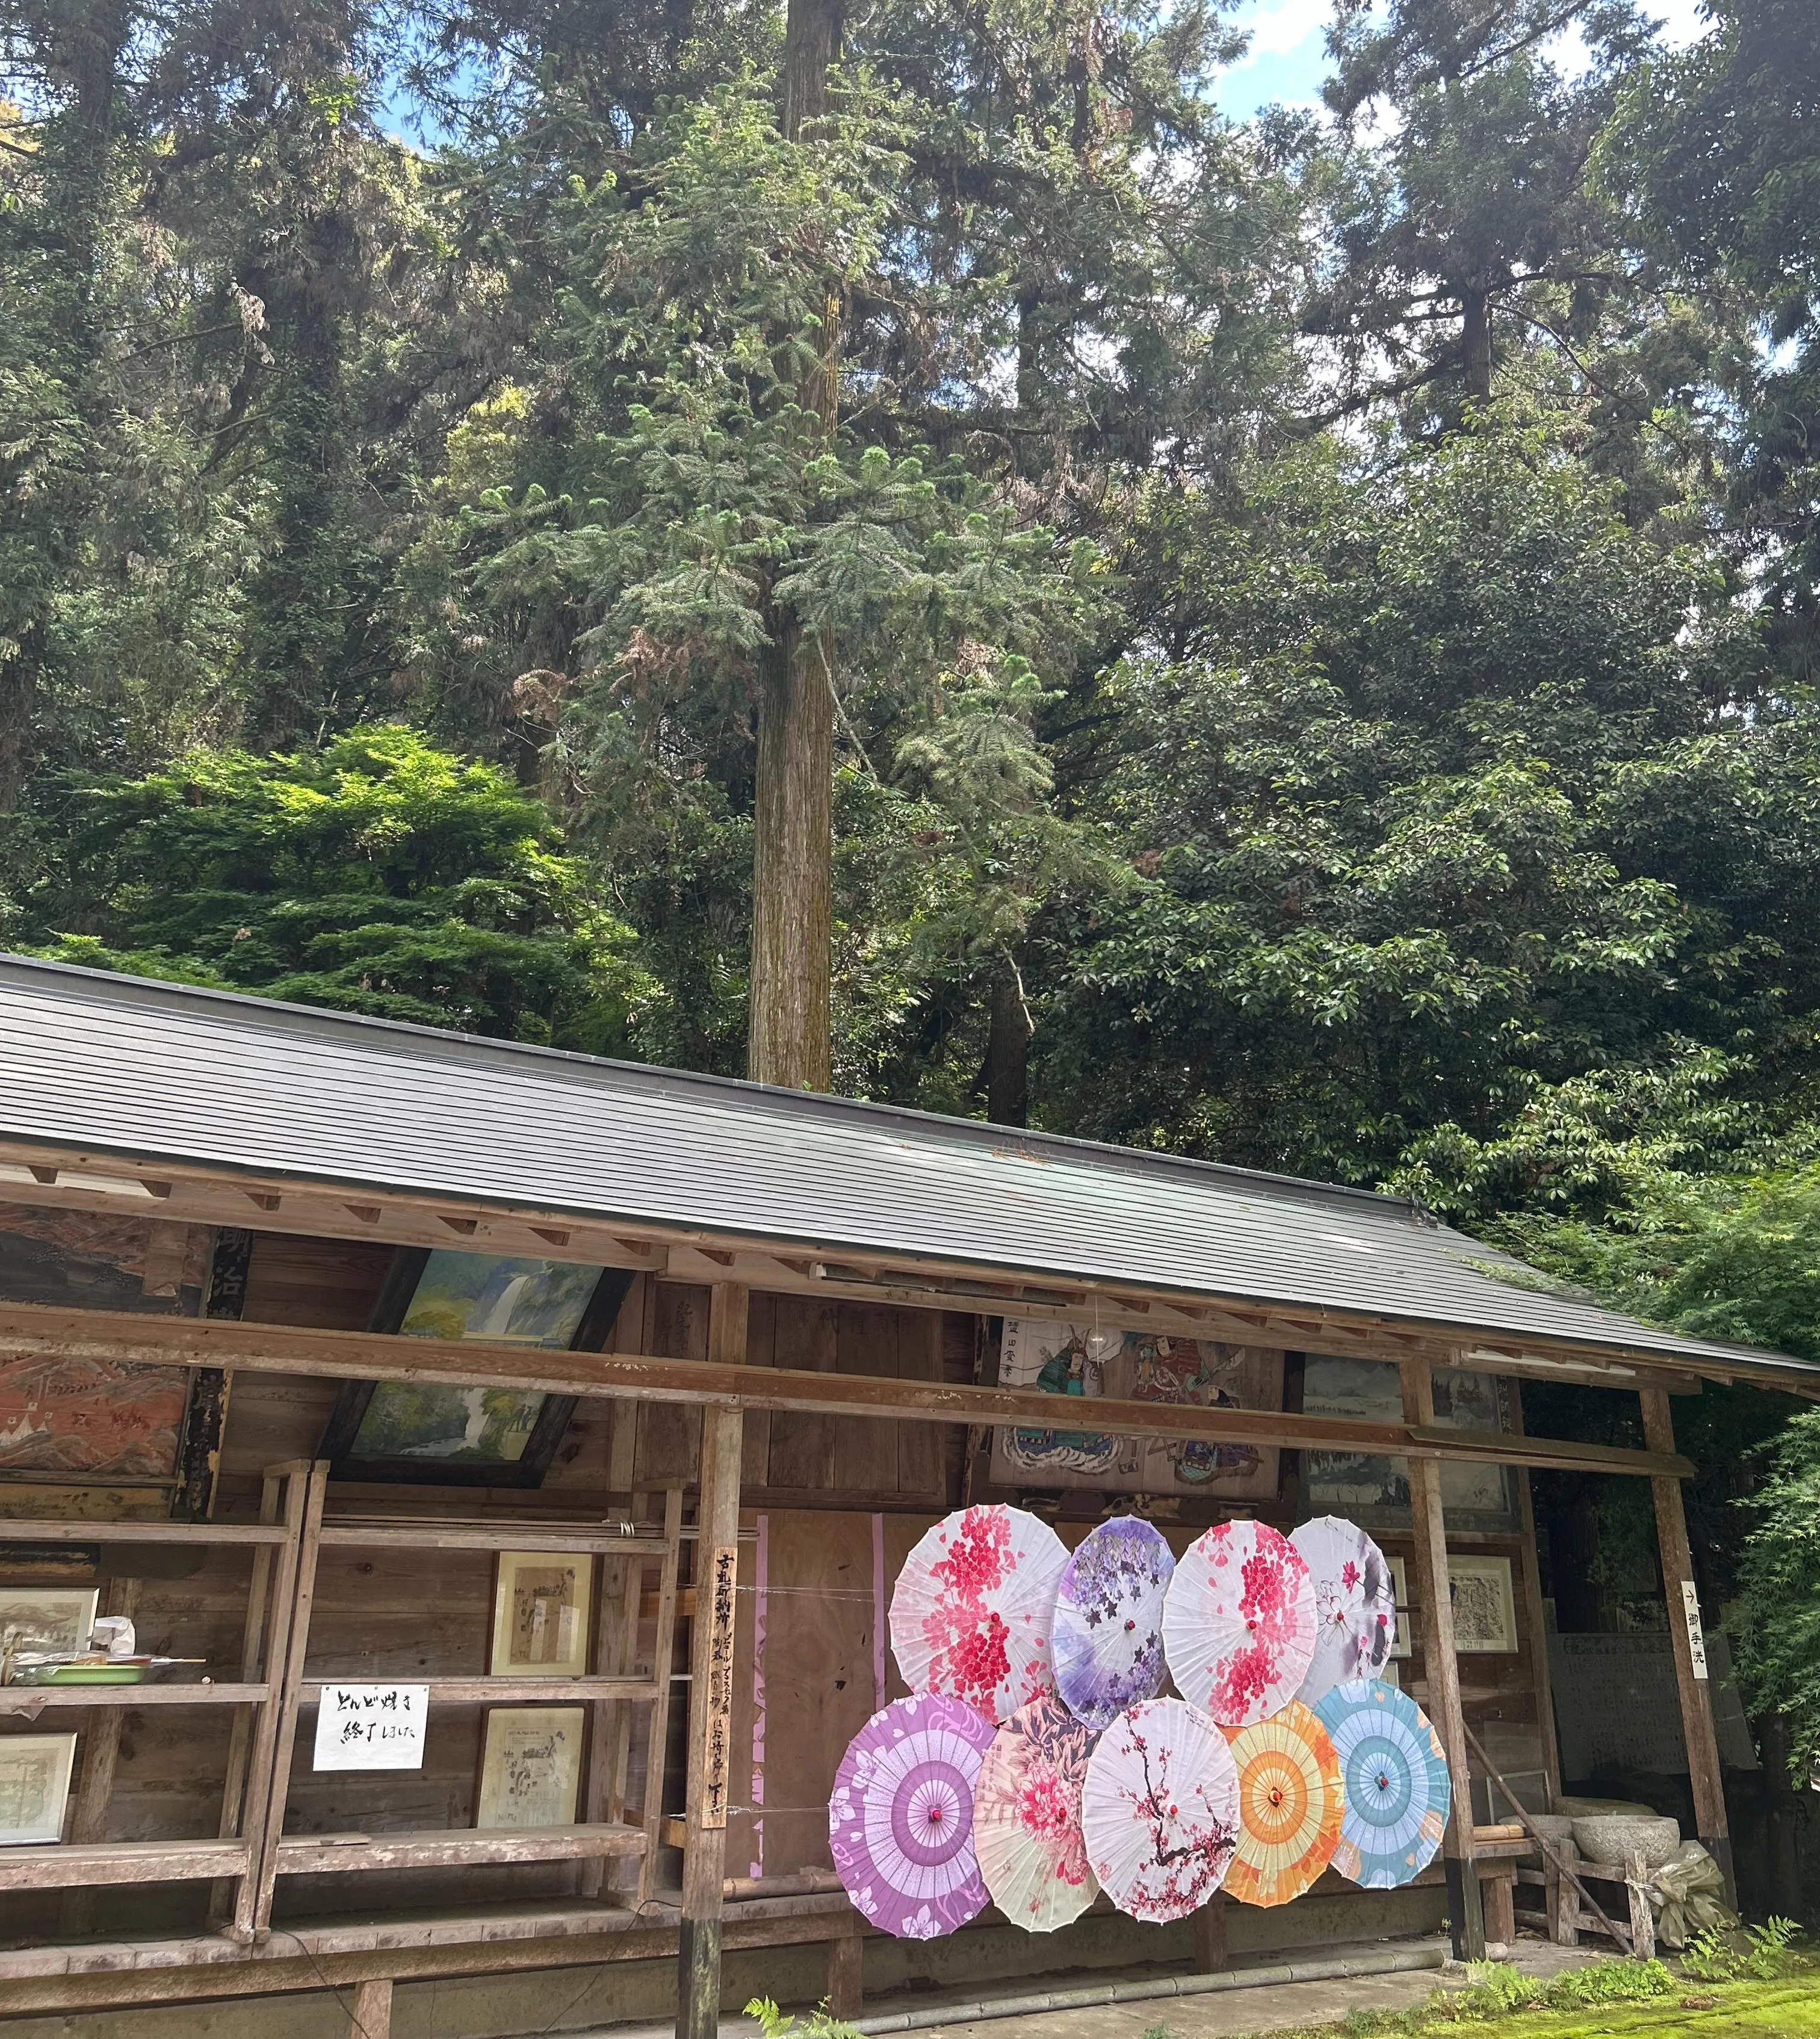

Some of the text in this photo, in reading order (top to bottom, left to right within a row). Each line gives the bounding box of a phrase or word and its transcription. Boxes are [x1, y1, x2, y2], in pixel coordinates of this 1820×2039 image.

[1688, 1613, 1704, 1663] 御手洗
[337, 1690, 410, 1712] どんど焼き
[340, 1721, 415, 1745] 終了しました
